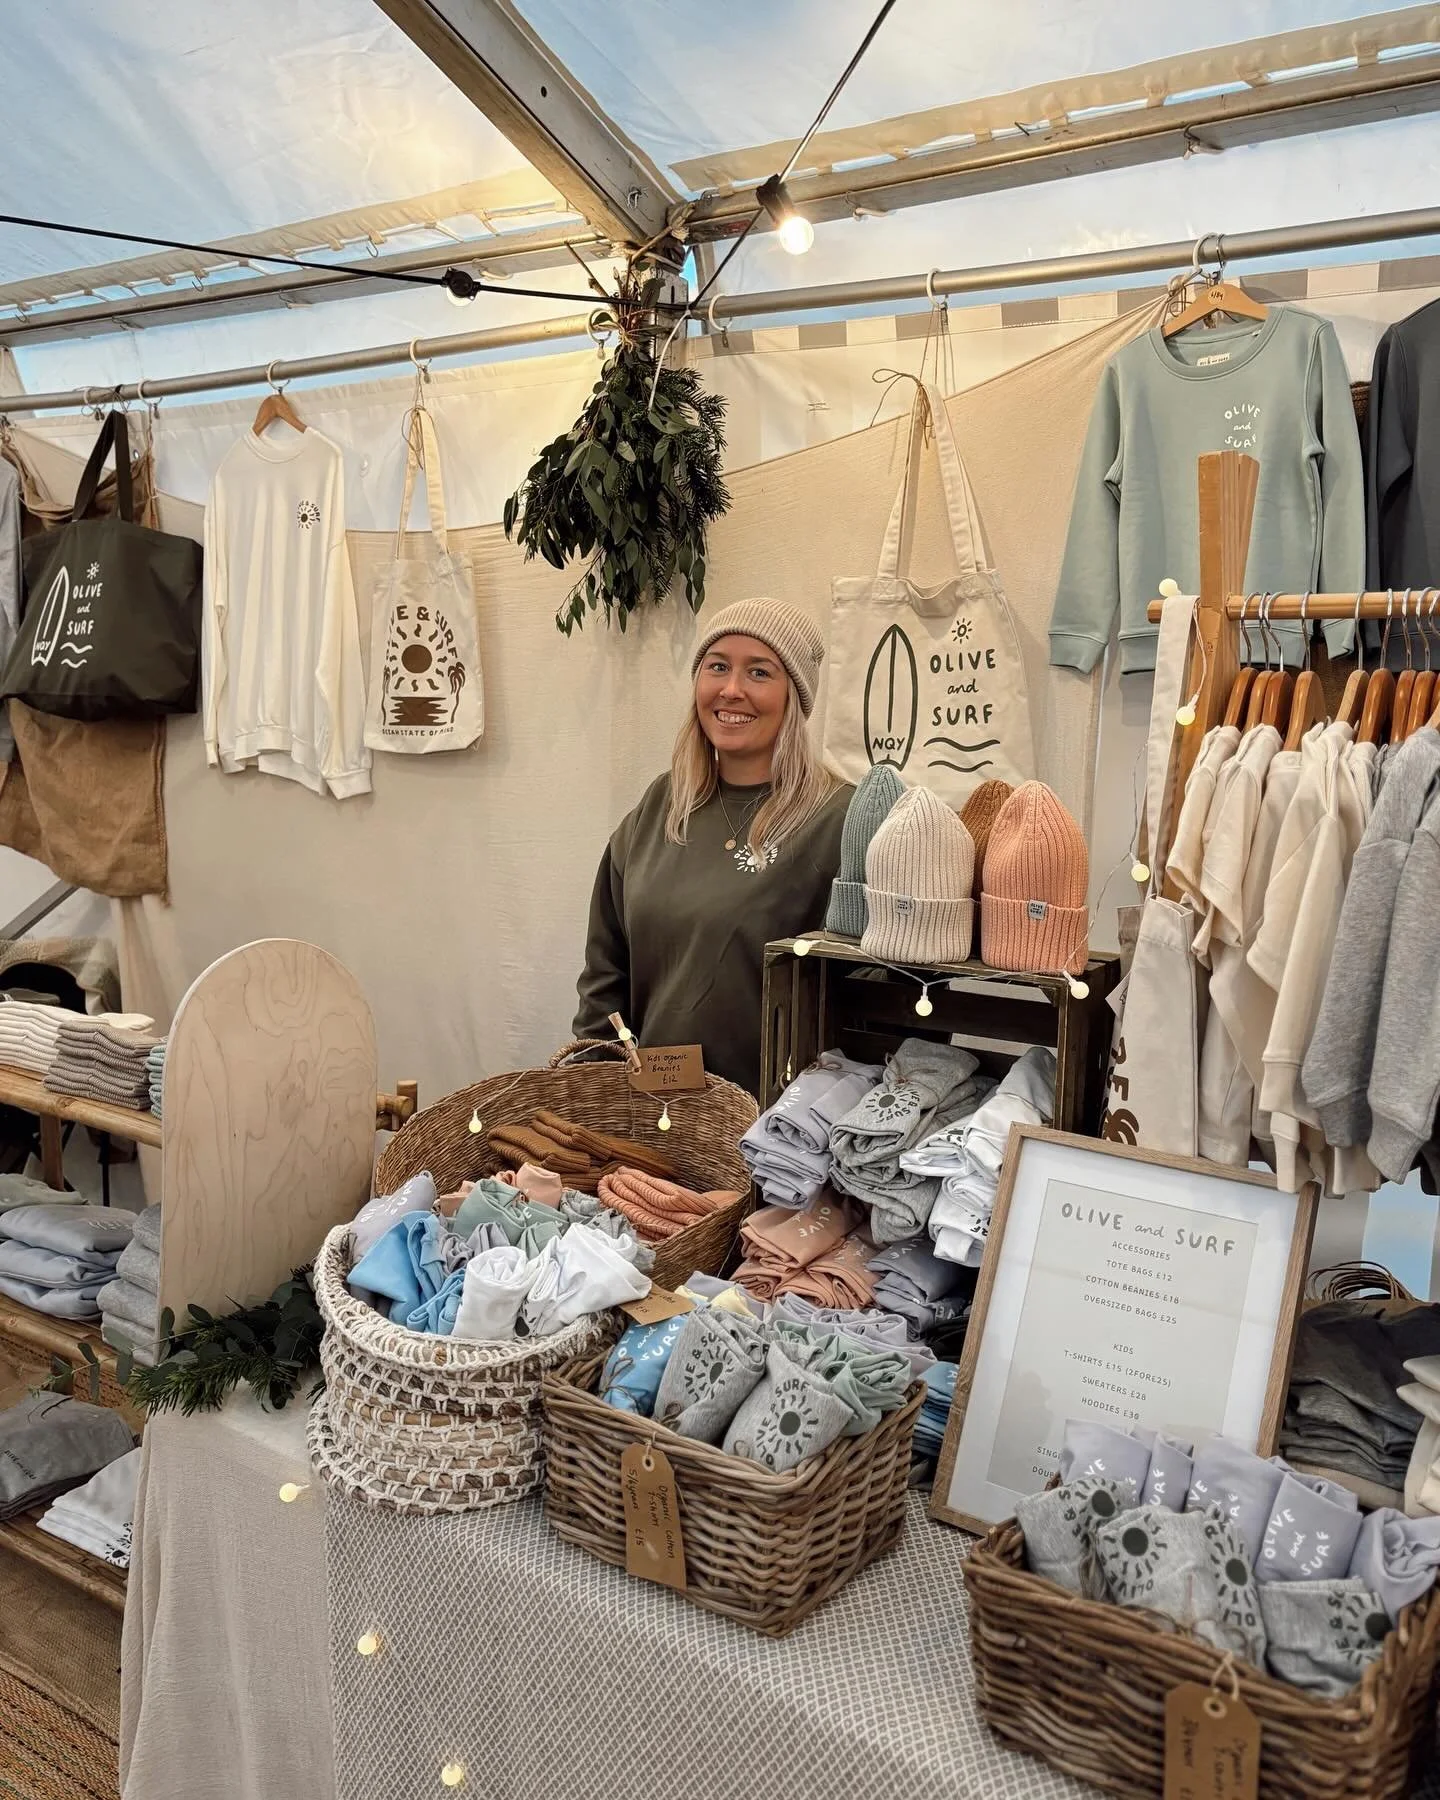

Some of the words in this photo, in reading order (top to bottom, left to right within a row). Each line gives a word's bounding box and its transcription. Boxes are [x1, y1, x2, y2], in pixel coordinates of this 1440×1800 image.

[1224, 403, 1261, 420] OLIVE
[1233, 422, 1252, 431] and
[1224, 433, 1257, 449] SURF
[72, 583, 104, 600] OLIVE
[76, 602, 91, 614] and
[66, 620, 95, 636] SURF
[434, 609, 459, 659] SURF
[35, 641, 51, 651] NQY
[930, 648, 997, 674] OLIVE
[947, 678, 980, 695] and
[931, 703, 994, 727] SURF
[662, 1074, 679, 1085] £12
[798, 1207, 832, 1238] OLIVE
[1061, 1202, 1124, 1231] OLIVE
[1134, 1223, 1165, 1238] and
[1175, 1228, 1236, 1257] SURF
[1111, 1240, 1171, 1261] ACCESSORIES
[1106, 1259, 1128, 1271] TOTE
[1131, 1265, 1153, 1277] BAGS
[1156, 1272, 1173, 1282] £12
[1086, 1274, 1120, 1289] COTTON
[1122, 1284, 1160, 1299] BEANIES
[1163, 1294, 1180, 1304] £18
[1084, 1294, 1132, 1313] OVERSIZED
[1135, 1307, 1157, 1320] BAGS
[1160, 1314, 1177, 1325] £25
[637, 1326, 658, 1350] and
[640, 1322, 680, 1361] SURF
[1113, 1343, 1134, 1355] KIDS
[1064, 1350, 1103, 1367] T-SHIRTS
[1106, 1362, 1122, 1372] £15
[684, 1363, 700, 1404] LIVE
[1081, 1376, 1127, 1395] SWEATERS
[1130, 1390, 1147, 1401] £28
[1081, 1396, 1120, 1414] HOODIES
[1123, 1409, 1140, 1420] £30
[756, 1416, 775, 1466] OLIVE
[775, 1379, 810, 1398] SURF
[1150, 1468, 1166, 1506] URF
[634, 1528, 645, 1547] £15
[1264, 1508, 1296, 1559] OLIVE
[1289, 1531, 1307, 1559] and
[1300, 1530, 1331, 1576] SURF
